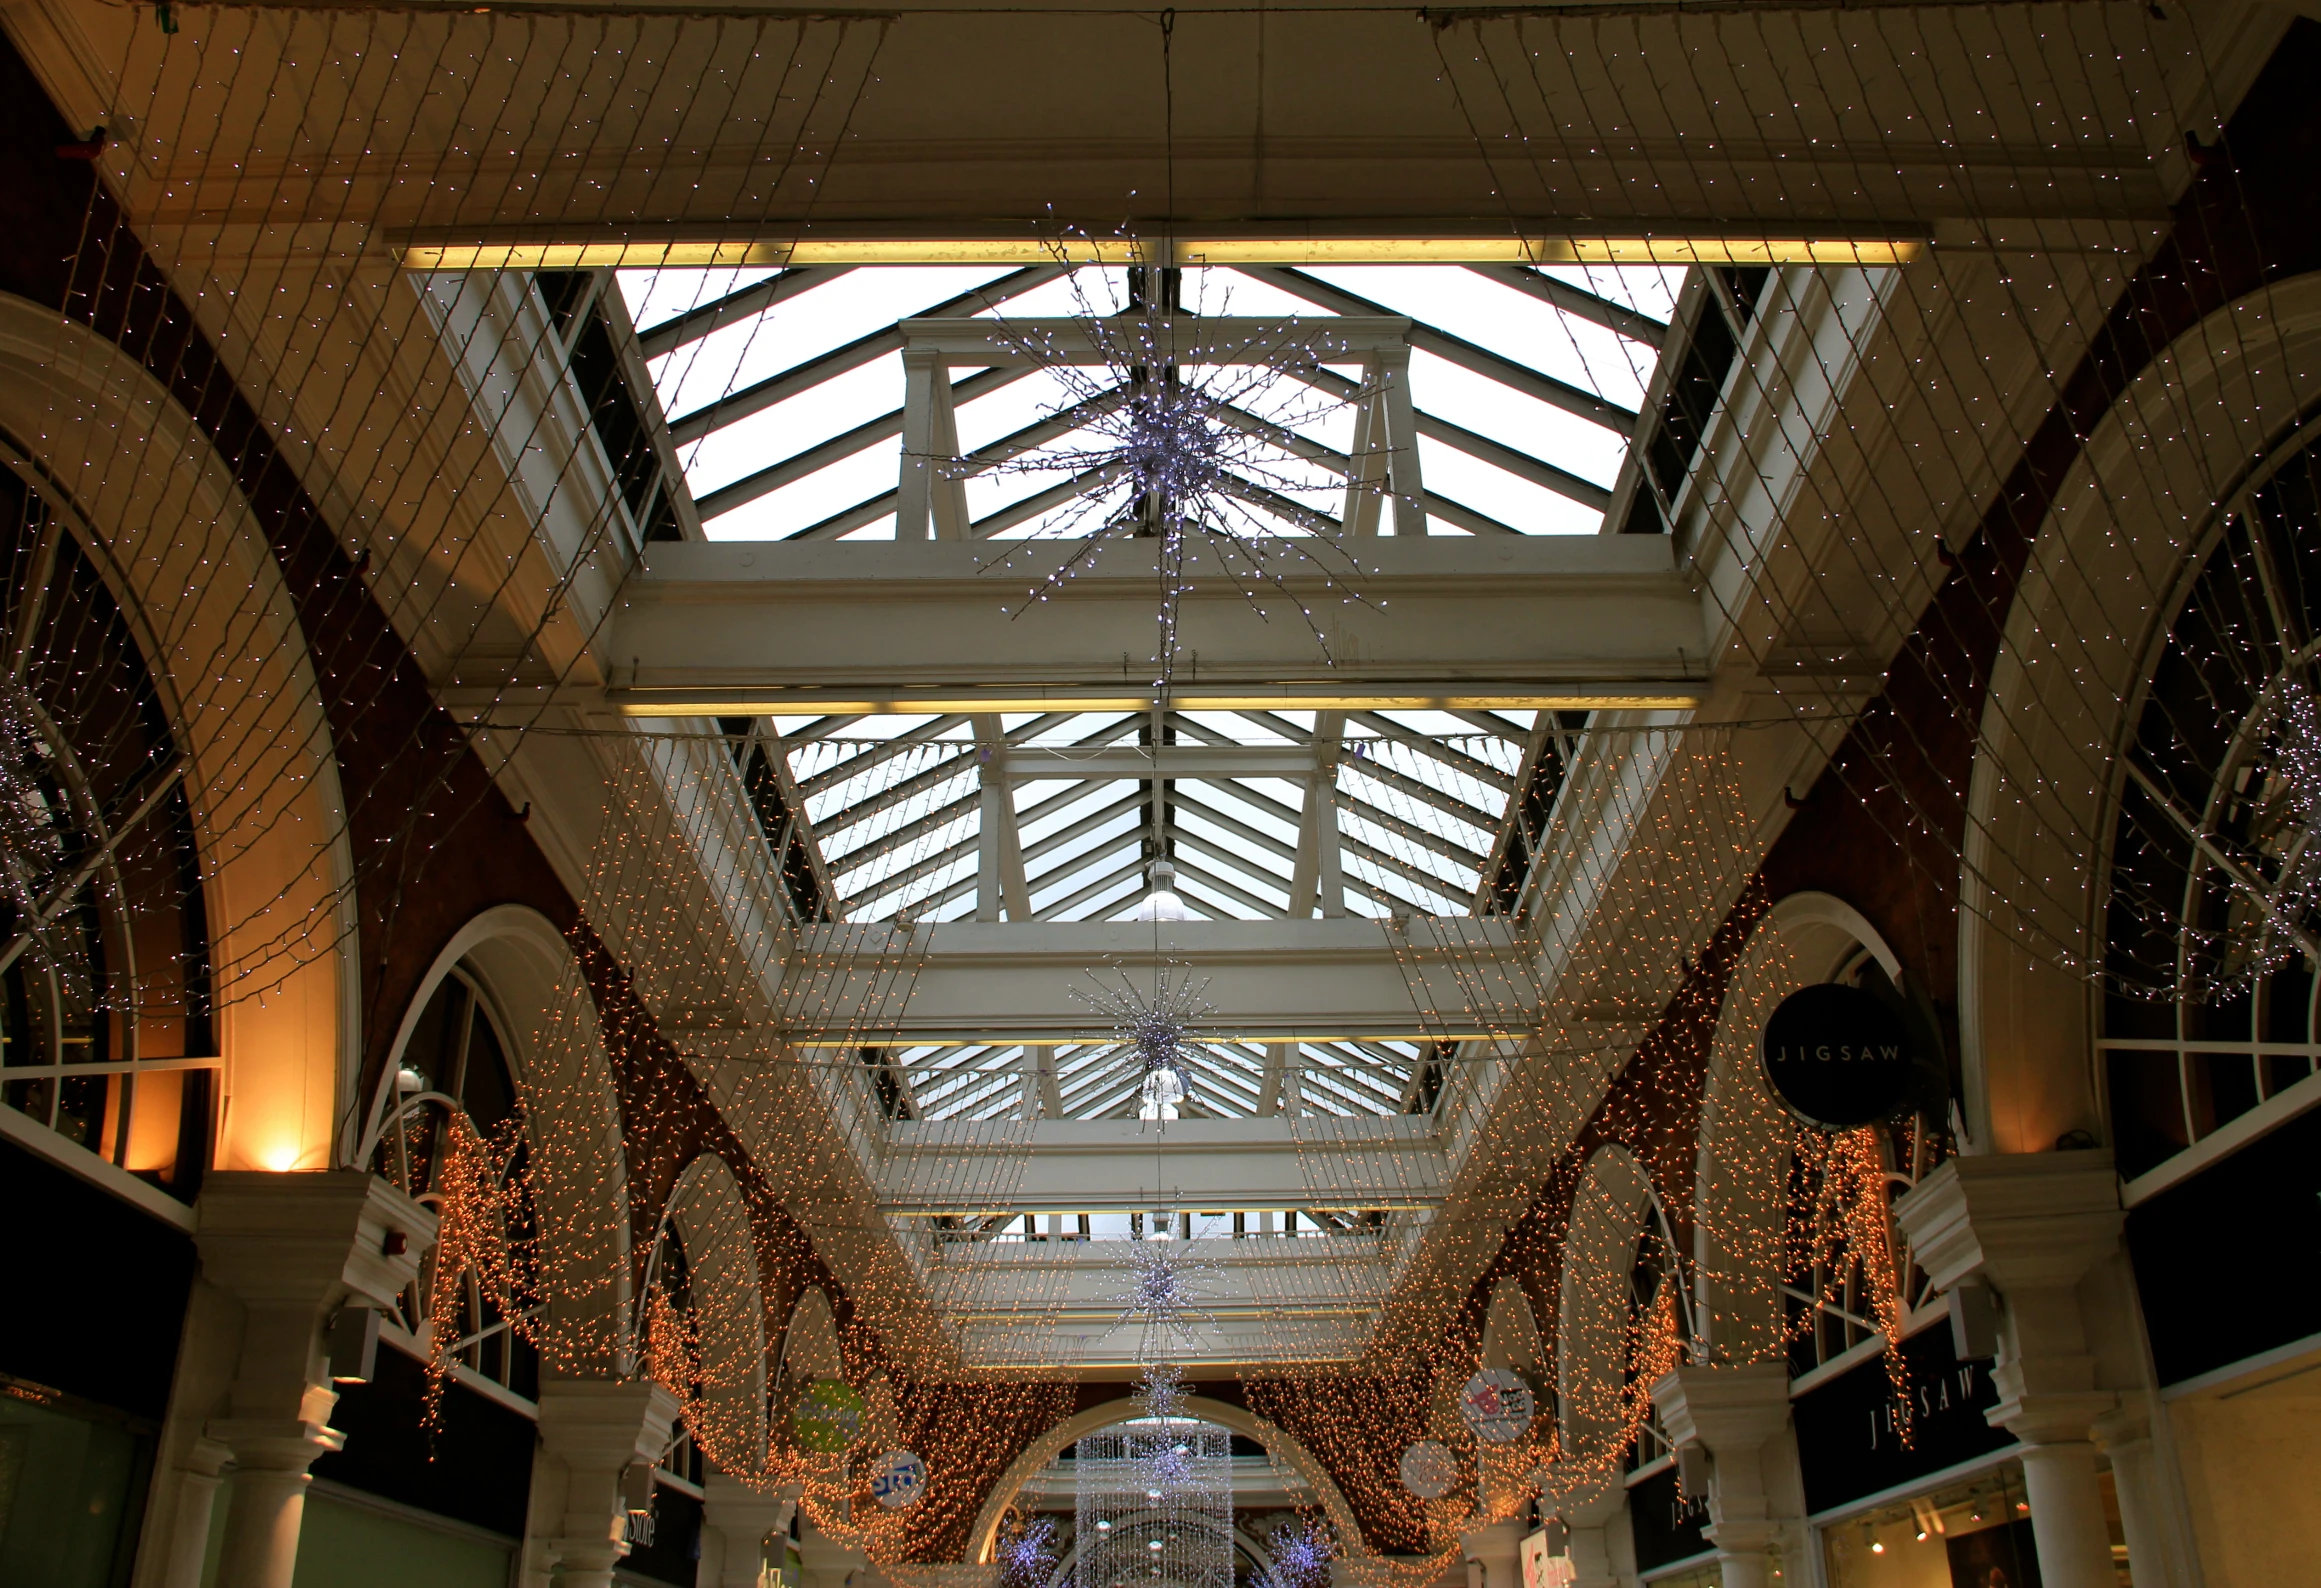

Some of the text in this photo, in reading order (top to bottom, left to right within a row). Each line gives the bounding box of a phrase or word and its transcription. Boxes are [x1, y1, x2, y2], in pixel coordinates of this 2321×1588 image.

[1777, 1045, 1899, 1061] JIGSAW
[1870, 1364, 1974, 1450] JIGSAW
[1671, 1494, 1703, 1531] JIGS
